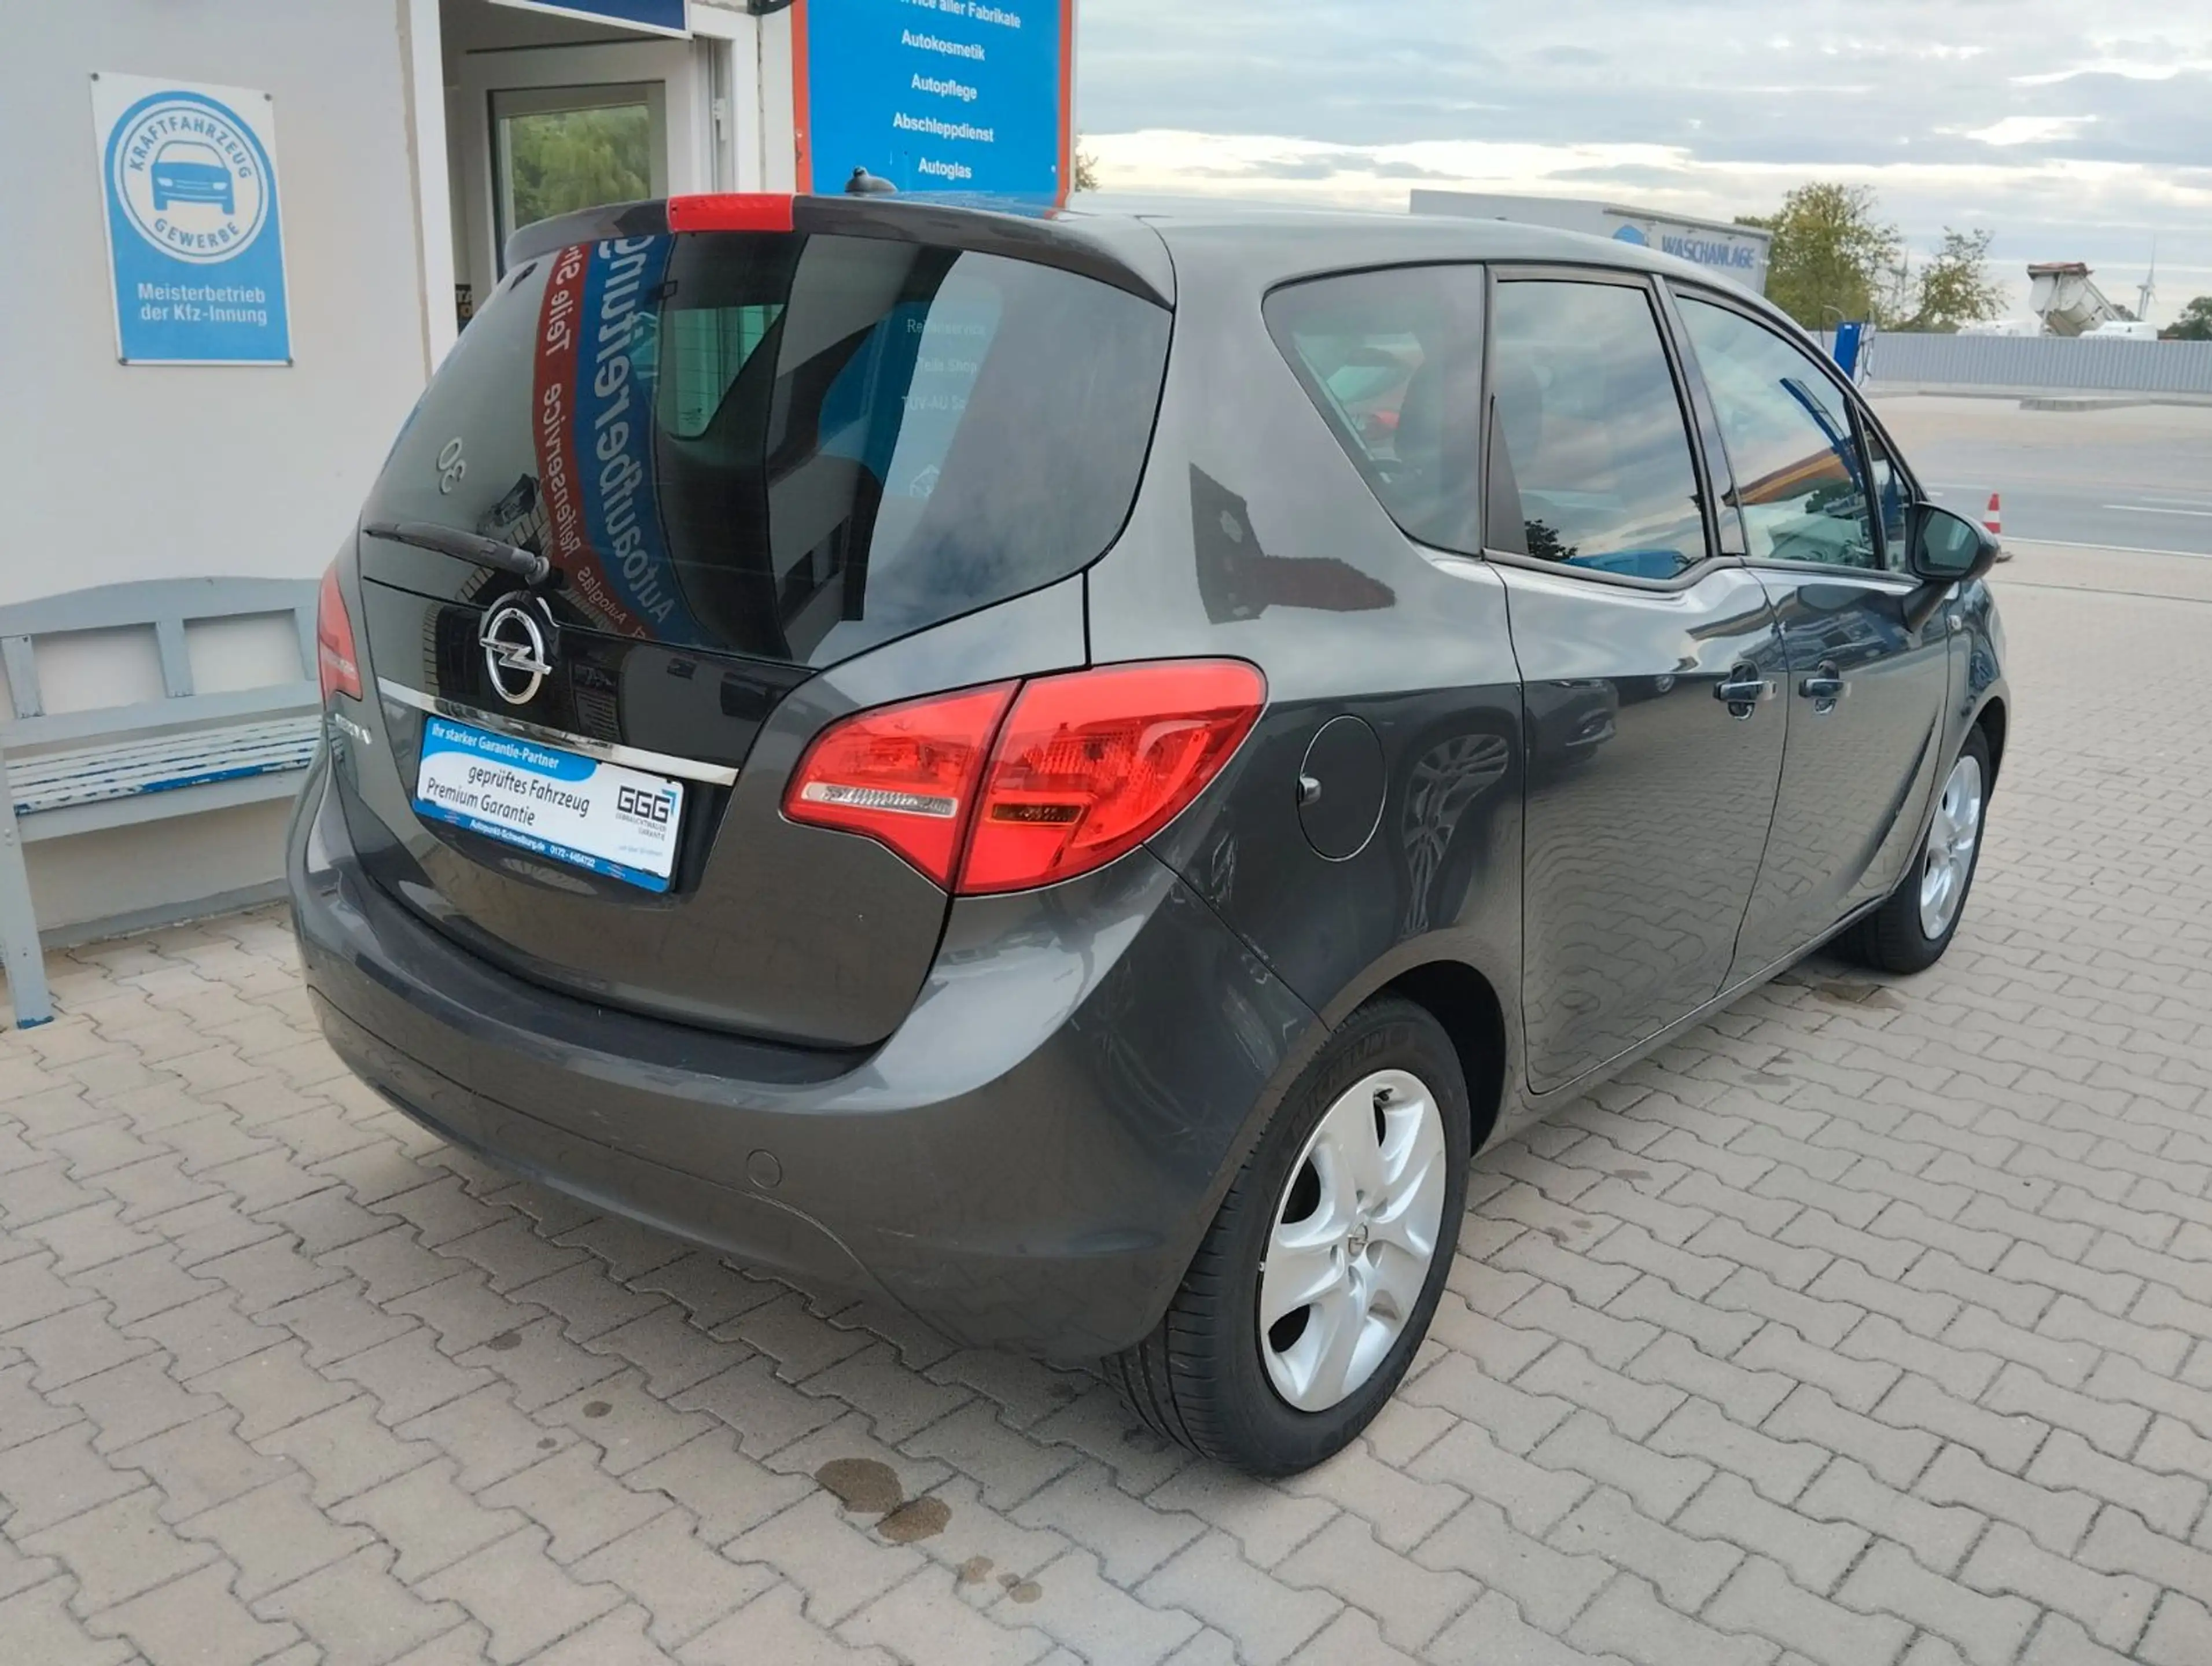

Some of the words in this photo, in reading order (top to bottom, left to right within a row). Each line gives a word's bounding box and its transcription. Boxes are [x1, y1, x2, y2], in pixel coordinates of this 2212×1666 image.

[939, 0, 966, 16] aller
[967, 2, 1021, 29] Fabrikate
[901, 28, 985, 61] Autokosmetik
[911, 72, 978, 102] Autopflege
[893, 112, 994, 143] Abschleppdienst
[130, 116, 252, 178] KRAFTFAHRZEUG
[918, 157, 972, 180] Autoglas
[154, 218, 240, 249] GEWERBE
[1662, 234, 1755, 269] WASCHANLAGE
[137, 282, 266, 304] Meisterbetrieb
[141, 303, 169, 320] der
[174, 303, 268, 327] Kfz-Innung
[432, 723, 444, 738] Ihr
[445, 728, 477, 747] starker
[478, 736, 560, 770] Garantie-Partner
[426, 777, 478, 809] Premium
[480, 794, 535, 827] Garantie
[468, 766, 527, 795] geprüftes
[529, 780, 590, 818] Fahrzeug
[617, 785, 671, 824] GGG
